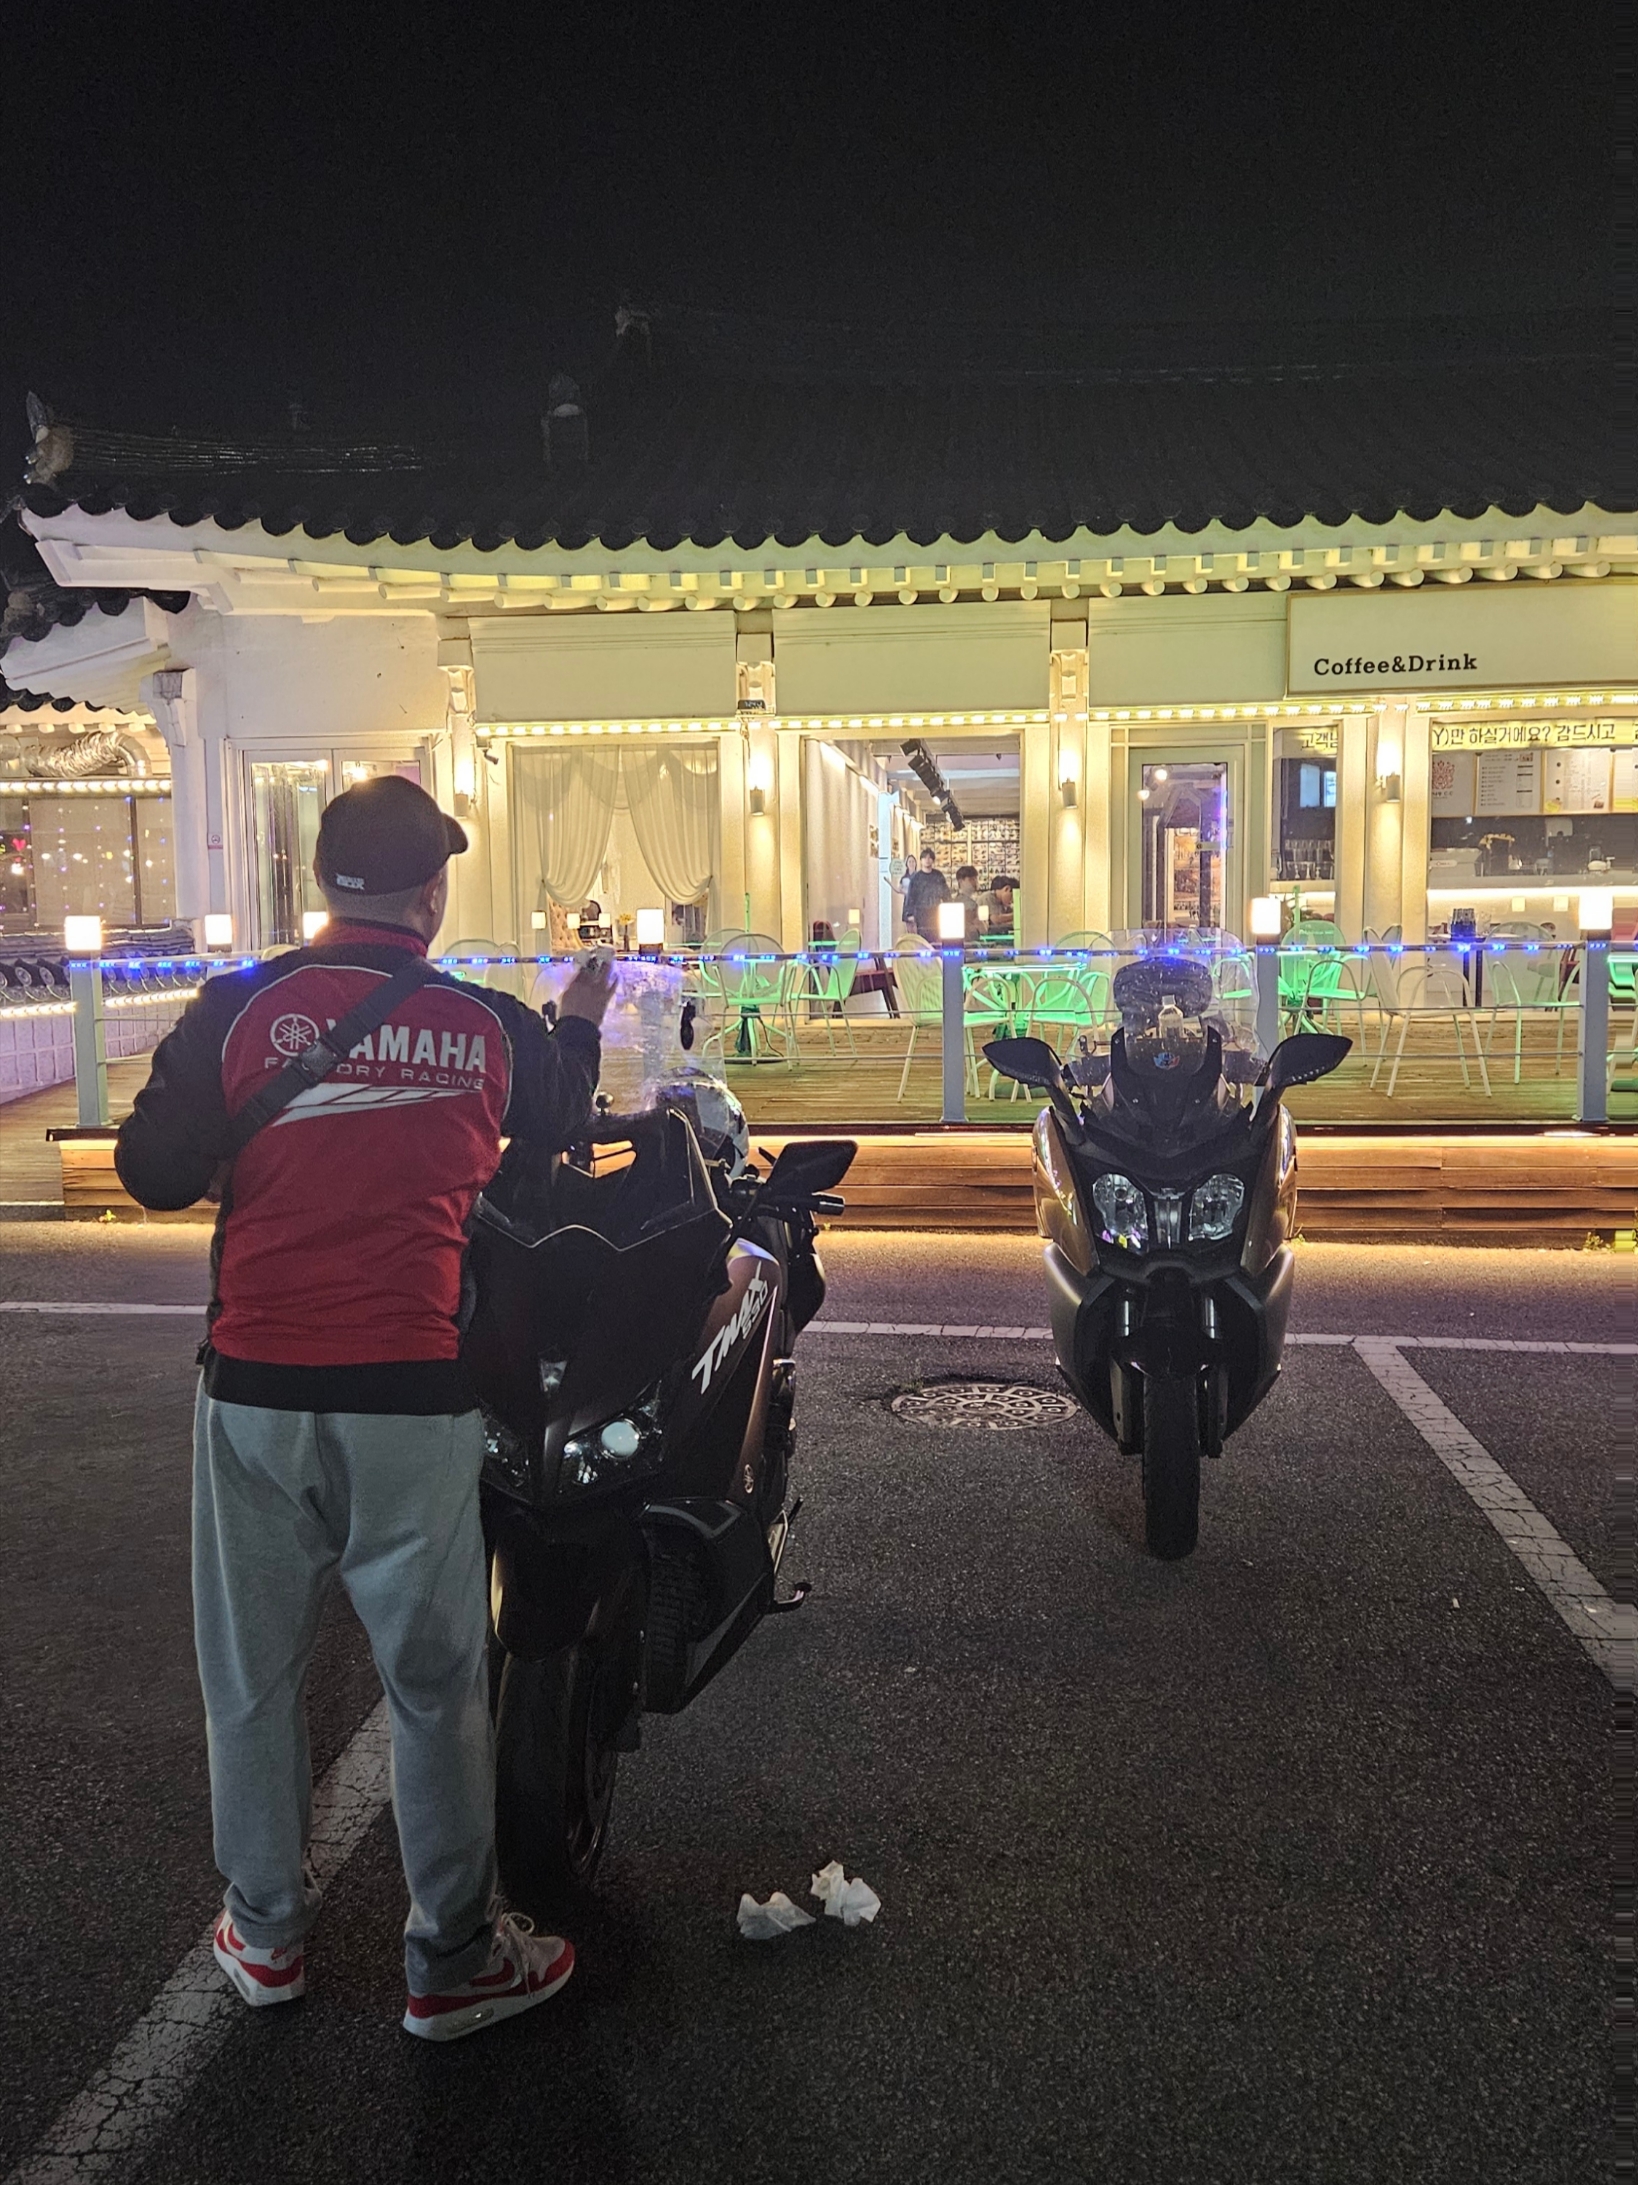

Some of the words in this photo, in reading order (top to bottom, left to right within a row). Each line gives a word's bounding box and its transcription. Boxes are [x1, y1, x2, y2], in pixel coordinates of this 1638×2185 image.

[1313, 653, 1478, 676] Coffee&Drink
[325, 1018, 487, 1074] AMAHA
[401, 1070, 485, 1090] RACING
